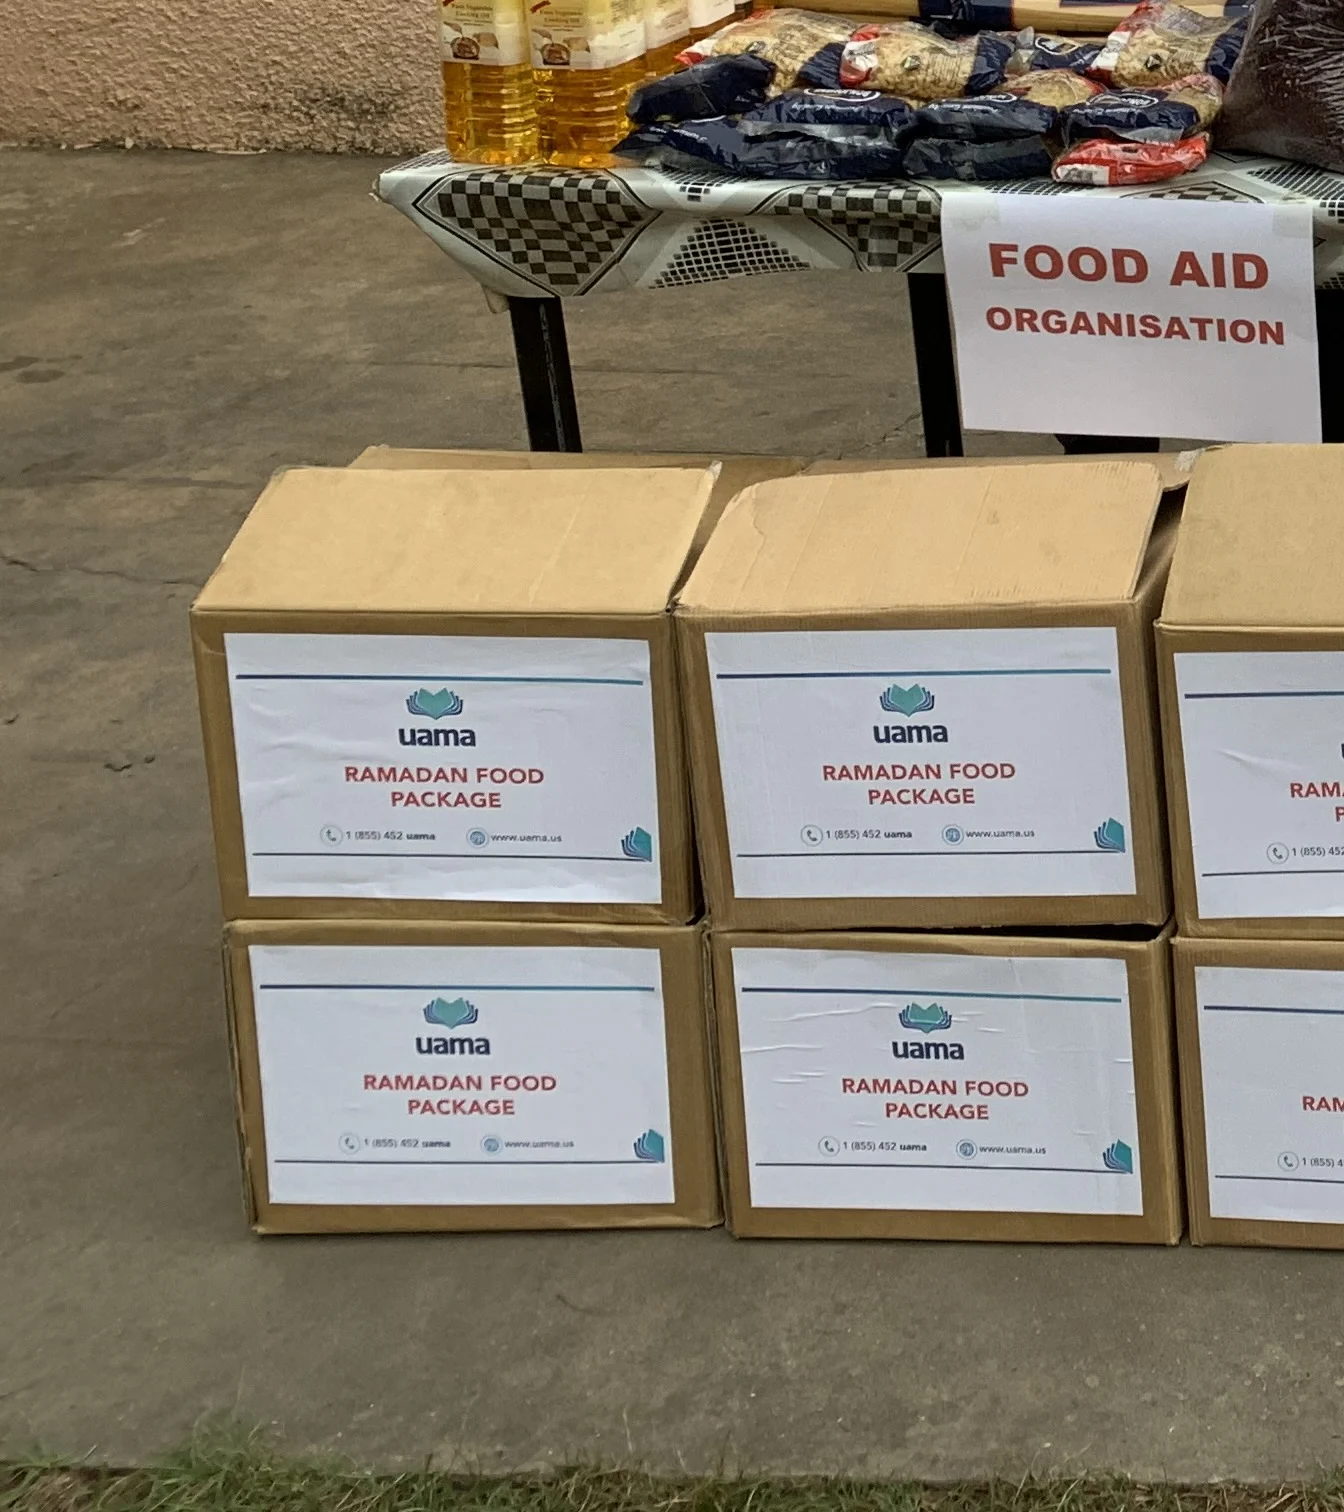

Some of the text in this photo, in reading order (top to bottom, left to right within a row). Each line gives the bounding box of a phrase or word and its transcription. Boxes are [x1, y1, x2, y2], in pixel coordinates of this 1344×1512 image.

[989, 243, 1268, 289] FOOD AID
[986, 307, 1284, 345] ORGANISATION
[399, 729, 476, 747] uama
[873, 725, 948, 743] uama
[345, 767, 544, 784] RAMADAN FOOD
[823, 763, 1015, 781] RAMADAN FOOD
[391, 792, 501, 808] PACKAGE
[868, 788, 975, 805] PACKAGE
[834, 830, 859, 840] (855)
[862, 830, 881, 838] 452
[1300, 847, 1325, 857] (855)
[416, 1037, 490, 1055] uama
[892, 1042, 964, 1060] uama
[364, 1075, 556, 1091] RAMADAN FOOD
[842, 1078, 1028, 1096] RAMADAN FOOD
[408, 1100, 515, 1115] PACKAGE
[886, 1103, 989, 1120] PACKAGE
[851, 1141, 876, 1151] (855)
[879, 1142, 896, 1150] 452
[1310, 1158, 1334, 1168] (855)
